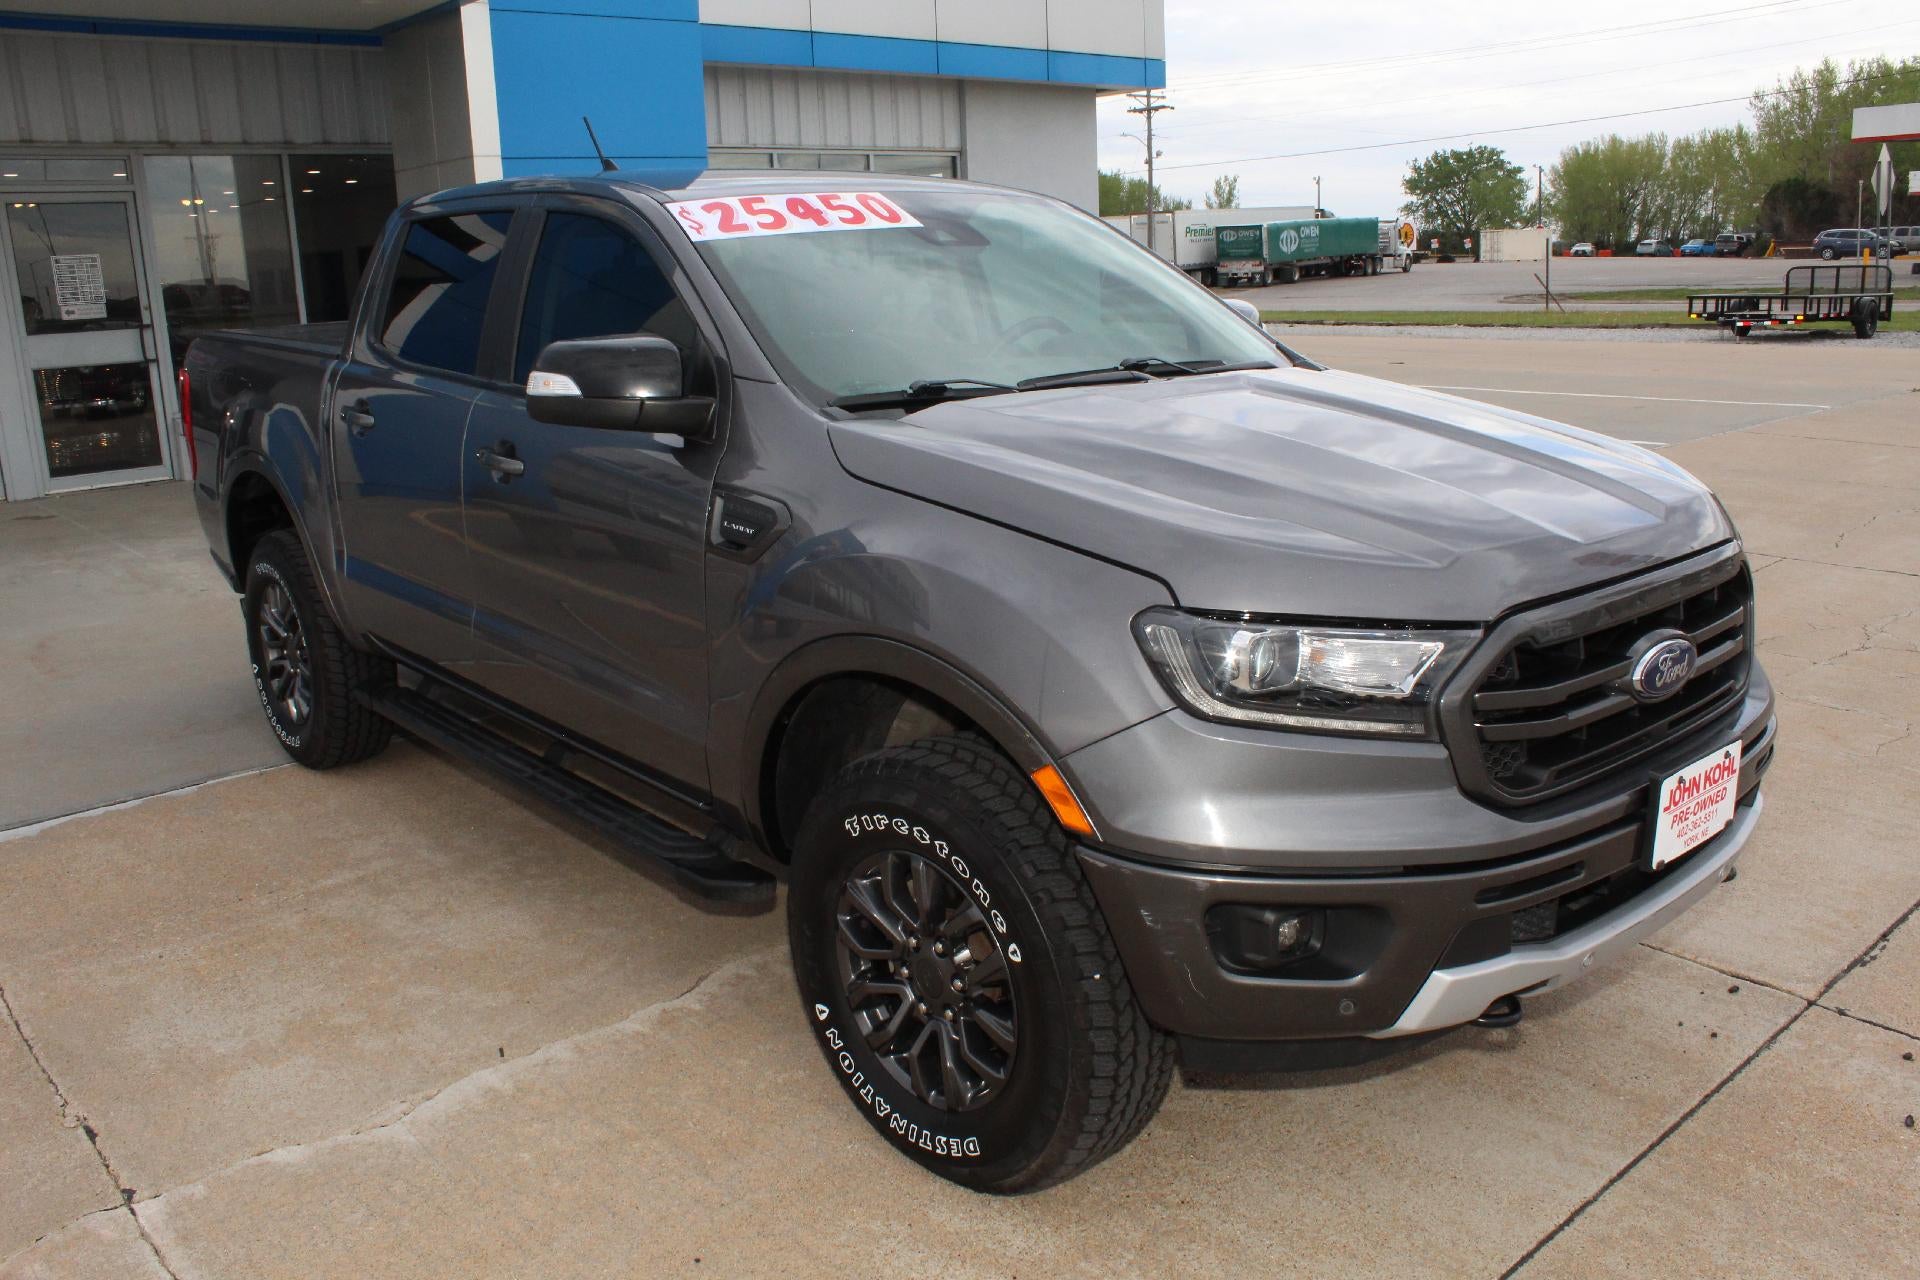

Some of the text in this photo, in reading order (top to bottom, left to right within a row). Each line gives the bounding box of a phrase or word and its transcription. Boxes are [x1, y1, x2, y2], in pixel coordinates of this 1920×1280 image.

[678, 194, 902, 237] $25450
[1185, 226, 1214, 237] Premier
[1300, 225, 1319, 238] OWEN
[1655, 650, 1688, 688] Ford
[1663, 756, 1737, 813] JOHN KOHL
[1671, 787, 1727, 830] PRE-OWNED
[826, 1029, 980, 1156] DESTINATION
